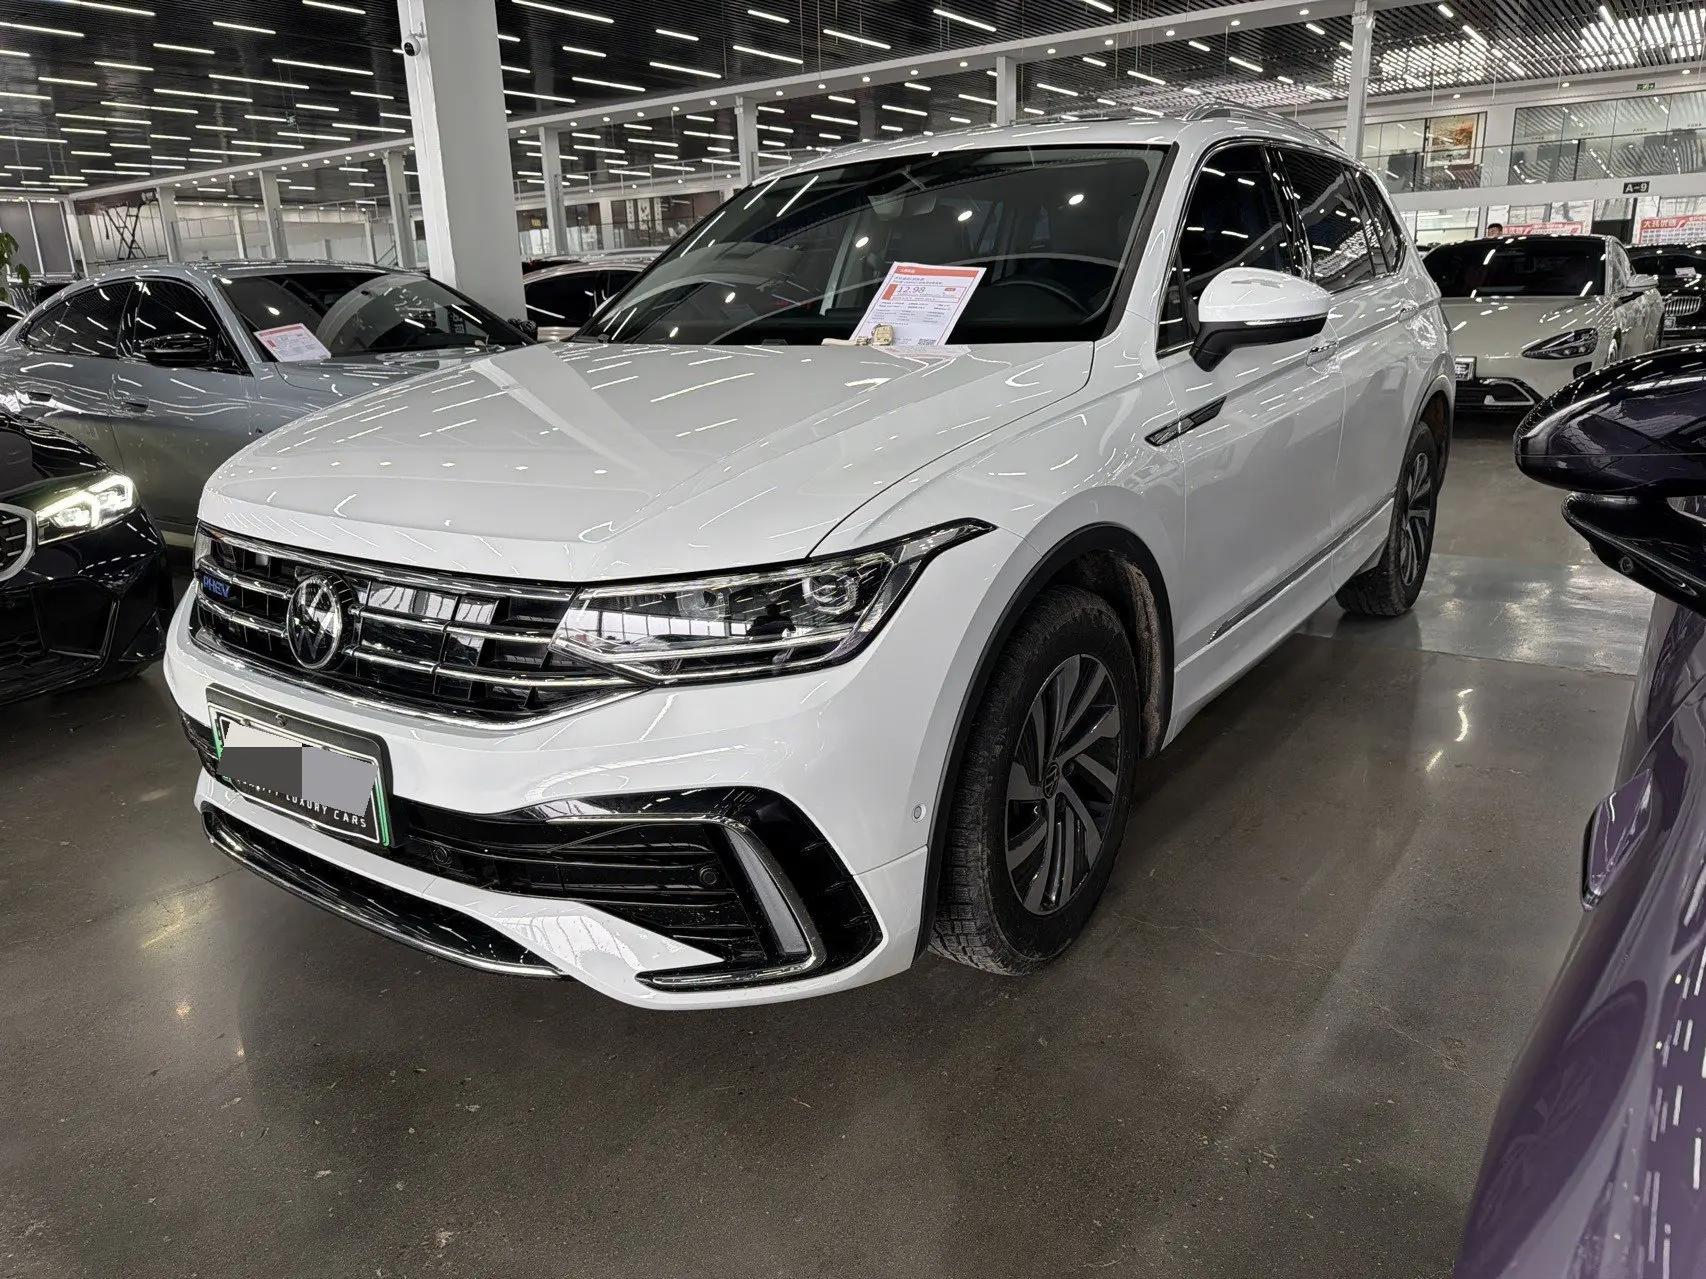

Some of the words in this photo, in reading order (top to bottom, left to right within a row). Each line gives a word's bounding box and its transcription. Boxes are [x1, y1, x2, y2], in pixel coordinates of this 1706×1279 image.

[1625, 182, 1648, 193] A-9
[897, 286, 926, 294] 12.98
[333, 810, 367, 828] CARS
